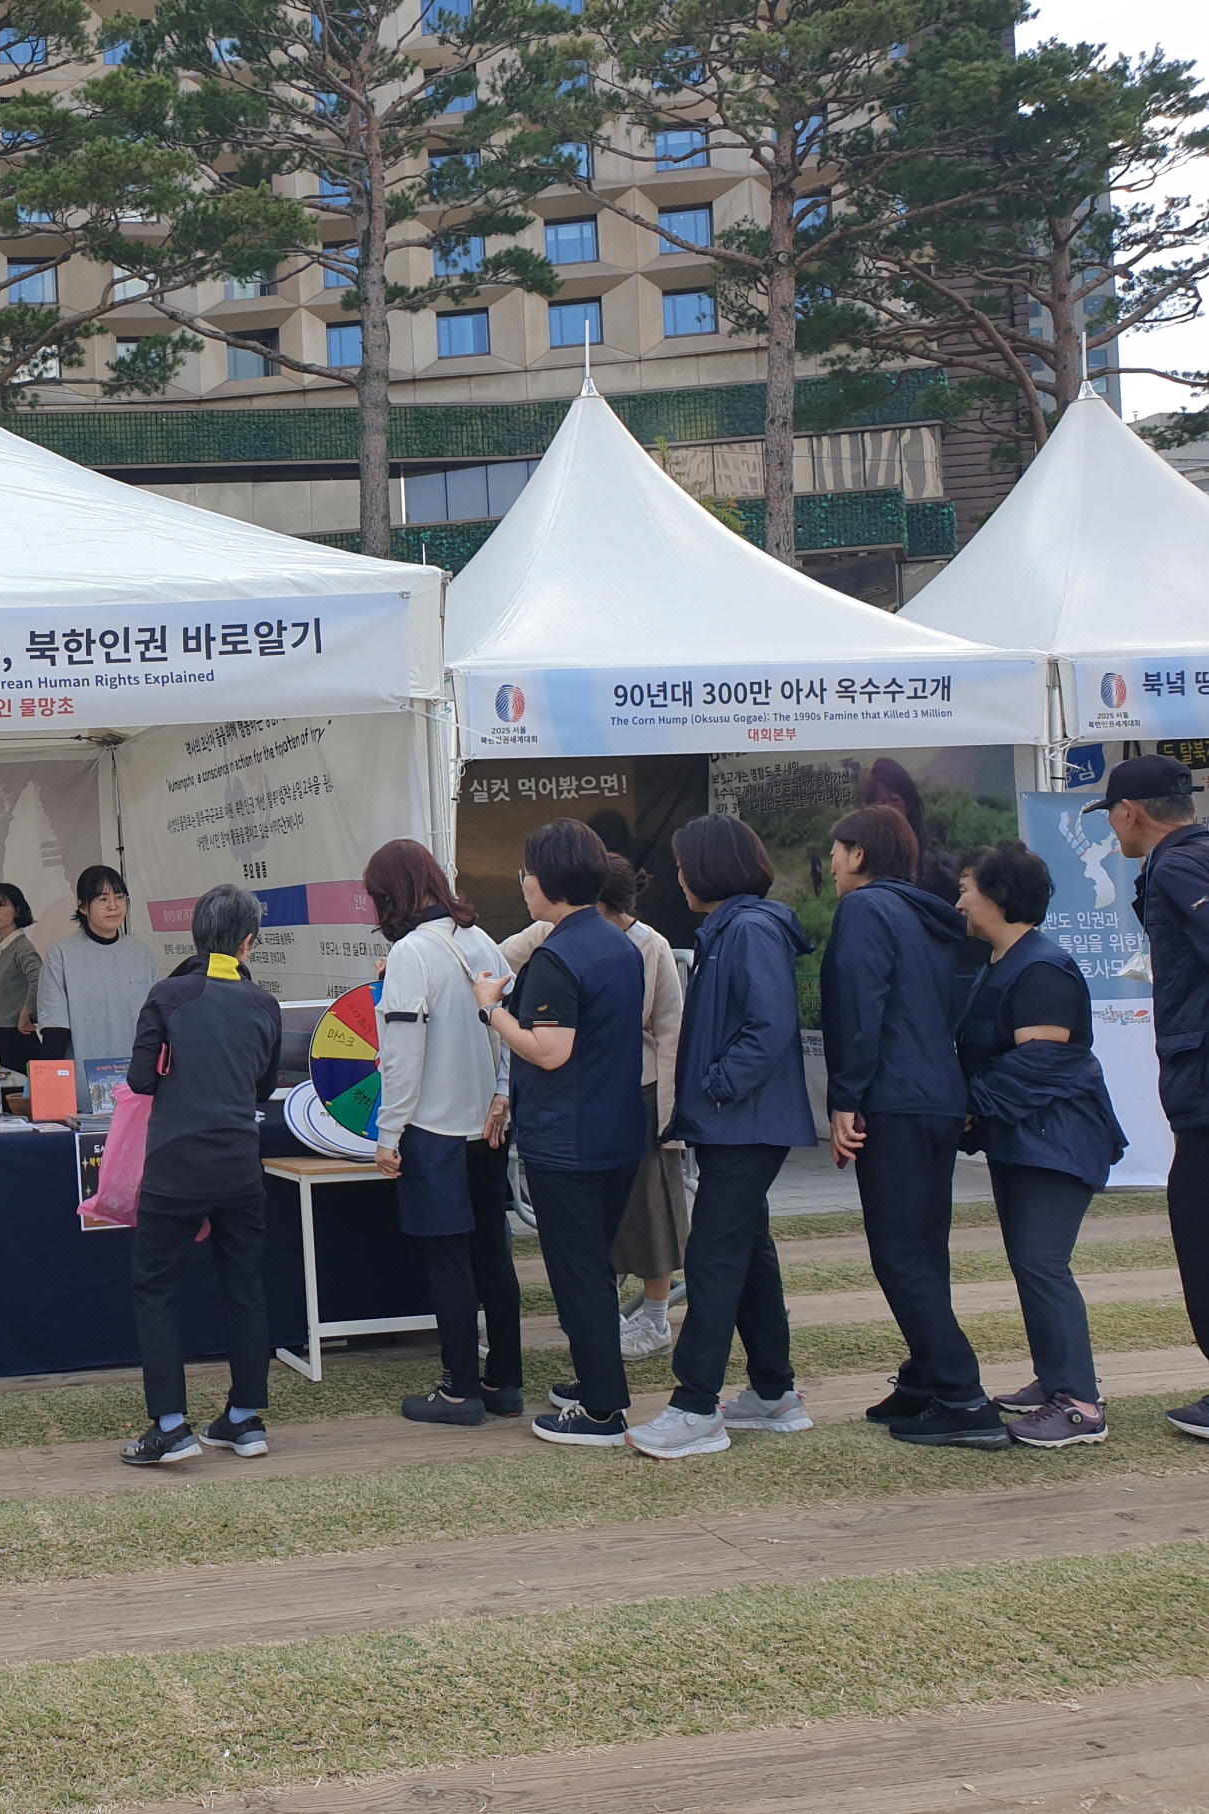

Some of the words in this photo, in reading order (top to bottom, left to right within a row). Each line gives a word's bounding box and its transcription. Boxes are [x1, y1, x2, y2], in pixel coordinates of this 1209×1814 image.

[25, 624, 169, 667] 북한인권
[182, 617, 323, 660] 바로알기
[37, 675, 90, 689] Human
[94, 673, 141, 690] Rights
[144, 669, 215, 687] Explained
[1142, 670, 1186, 697] 북녘
[613, 681, 693, 708] 90년대
[702, 679, 772, 706] 300만
[780, 678, 828, 706] 아사
[835, 675, 952, 703] 옥수수고개
[18, 696, 75, 718] 물망초
[610, 716, 629, 726] The
[631, 715, 656, 726] Corn
[658, 715, 688, 728] Hump
[691, 713, 730, 726] (Oksusu
[733, 711, 771, 725] Gogae):
[772, 711, 791, 723] The
[793, 711, 821, 722] 1990s
[823, 710, 859, 721] Famine
[861, 710, 882, 721] that
[883, 709, 911, 720] Killed
[912, 710, 919, 719] 3
[921, 708, 953, 719] Million
[1116, 711, 1129, 719] 서울
[491, 727, 511, 735] 2025
[512, 725, 527, 735] 서울
[747, 727, 798, 742] 대회본부
[196, 774, 202, 784] a
[202, 762, 230, 782] conscience
[229, 758, 235, 773] in
[234, 753, 254, 771] action
[253, 748, 263, 764] for
[263, 744, 275, 761] the
[300, 727, 309, 746] of
[750, 767, 773, 782] 명함도
[773, 763, 783, 777] 못
[783, 760, 800, 776] 내밀
[469, 777, 511, 804] 실컷
[517, 773, 628, 801] 먹어봤으면!
[713, 782, 766, 801] 옥수수고개에서
[765, 781, 782, 795] 가장
[817, 770, 850, 788] 돌아가신
[751, 797, 784, 814] 대한민국
[1042, 911, 1073, 930] 반도
[1076, 911, 1120, 930] 인권과
[1058, 933, 1104, 954] 통일을
[1108, 931, 1144, 953] 위한
[326, 1027, 356, 1048] 마스크
